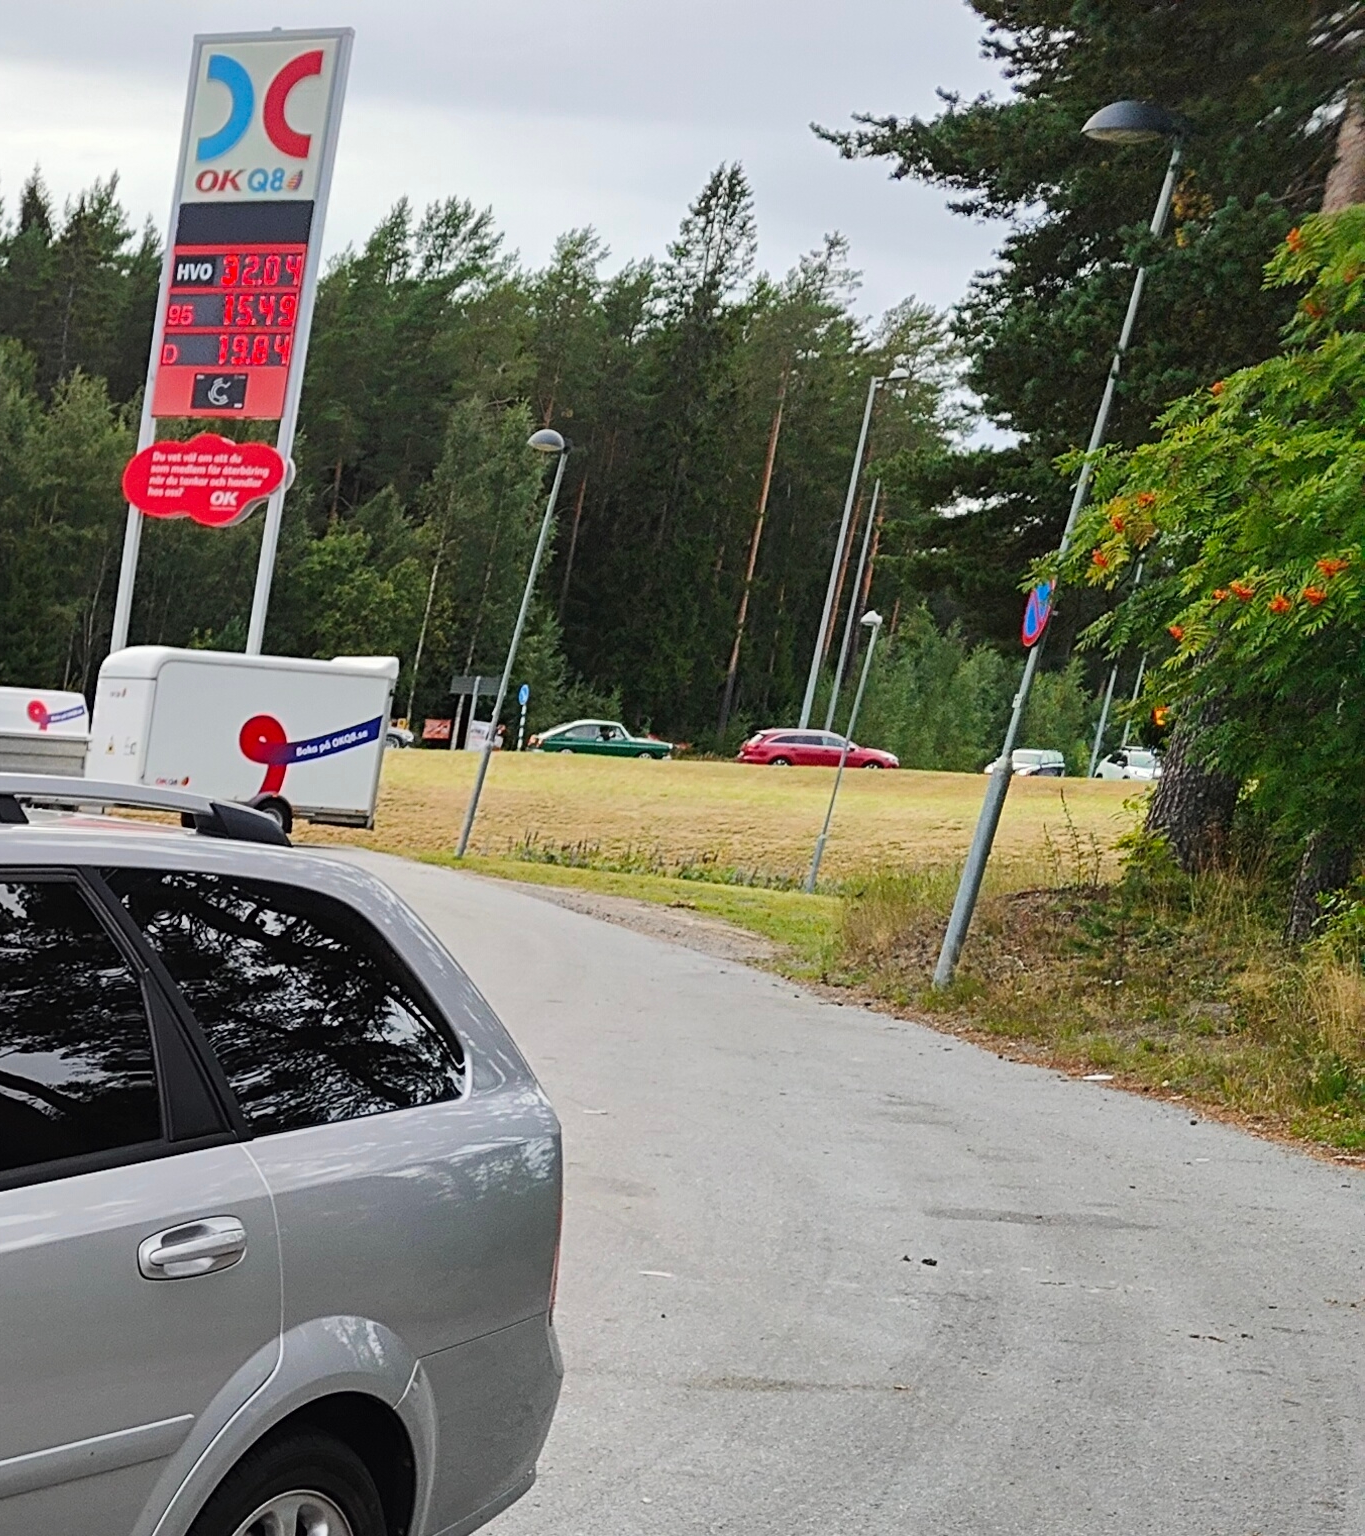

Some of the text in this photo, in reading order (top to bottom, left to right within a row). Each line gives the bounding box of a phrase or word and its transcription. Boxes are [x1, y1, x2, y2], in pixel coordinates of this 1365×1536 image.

[176, 263, 213, 281] HVO
[168, 305, 194, 326] 95
[162, 344, 178, 365] D
[210, 491, 239, 506] OK
[295, 745, 318, 757] Boka
[319, 740, 331, 753] på
